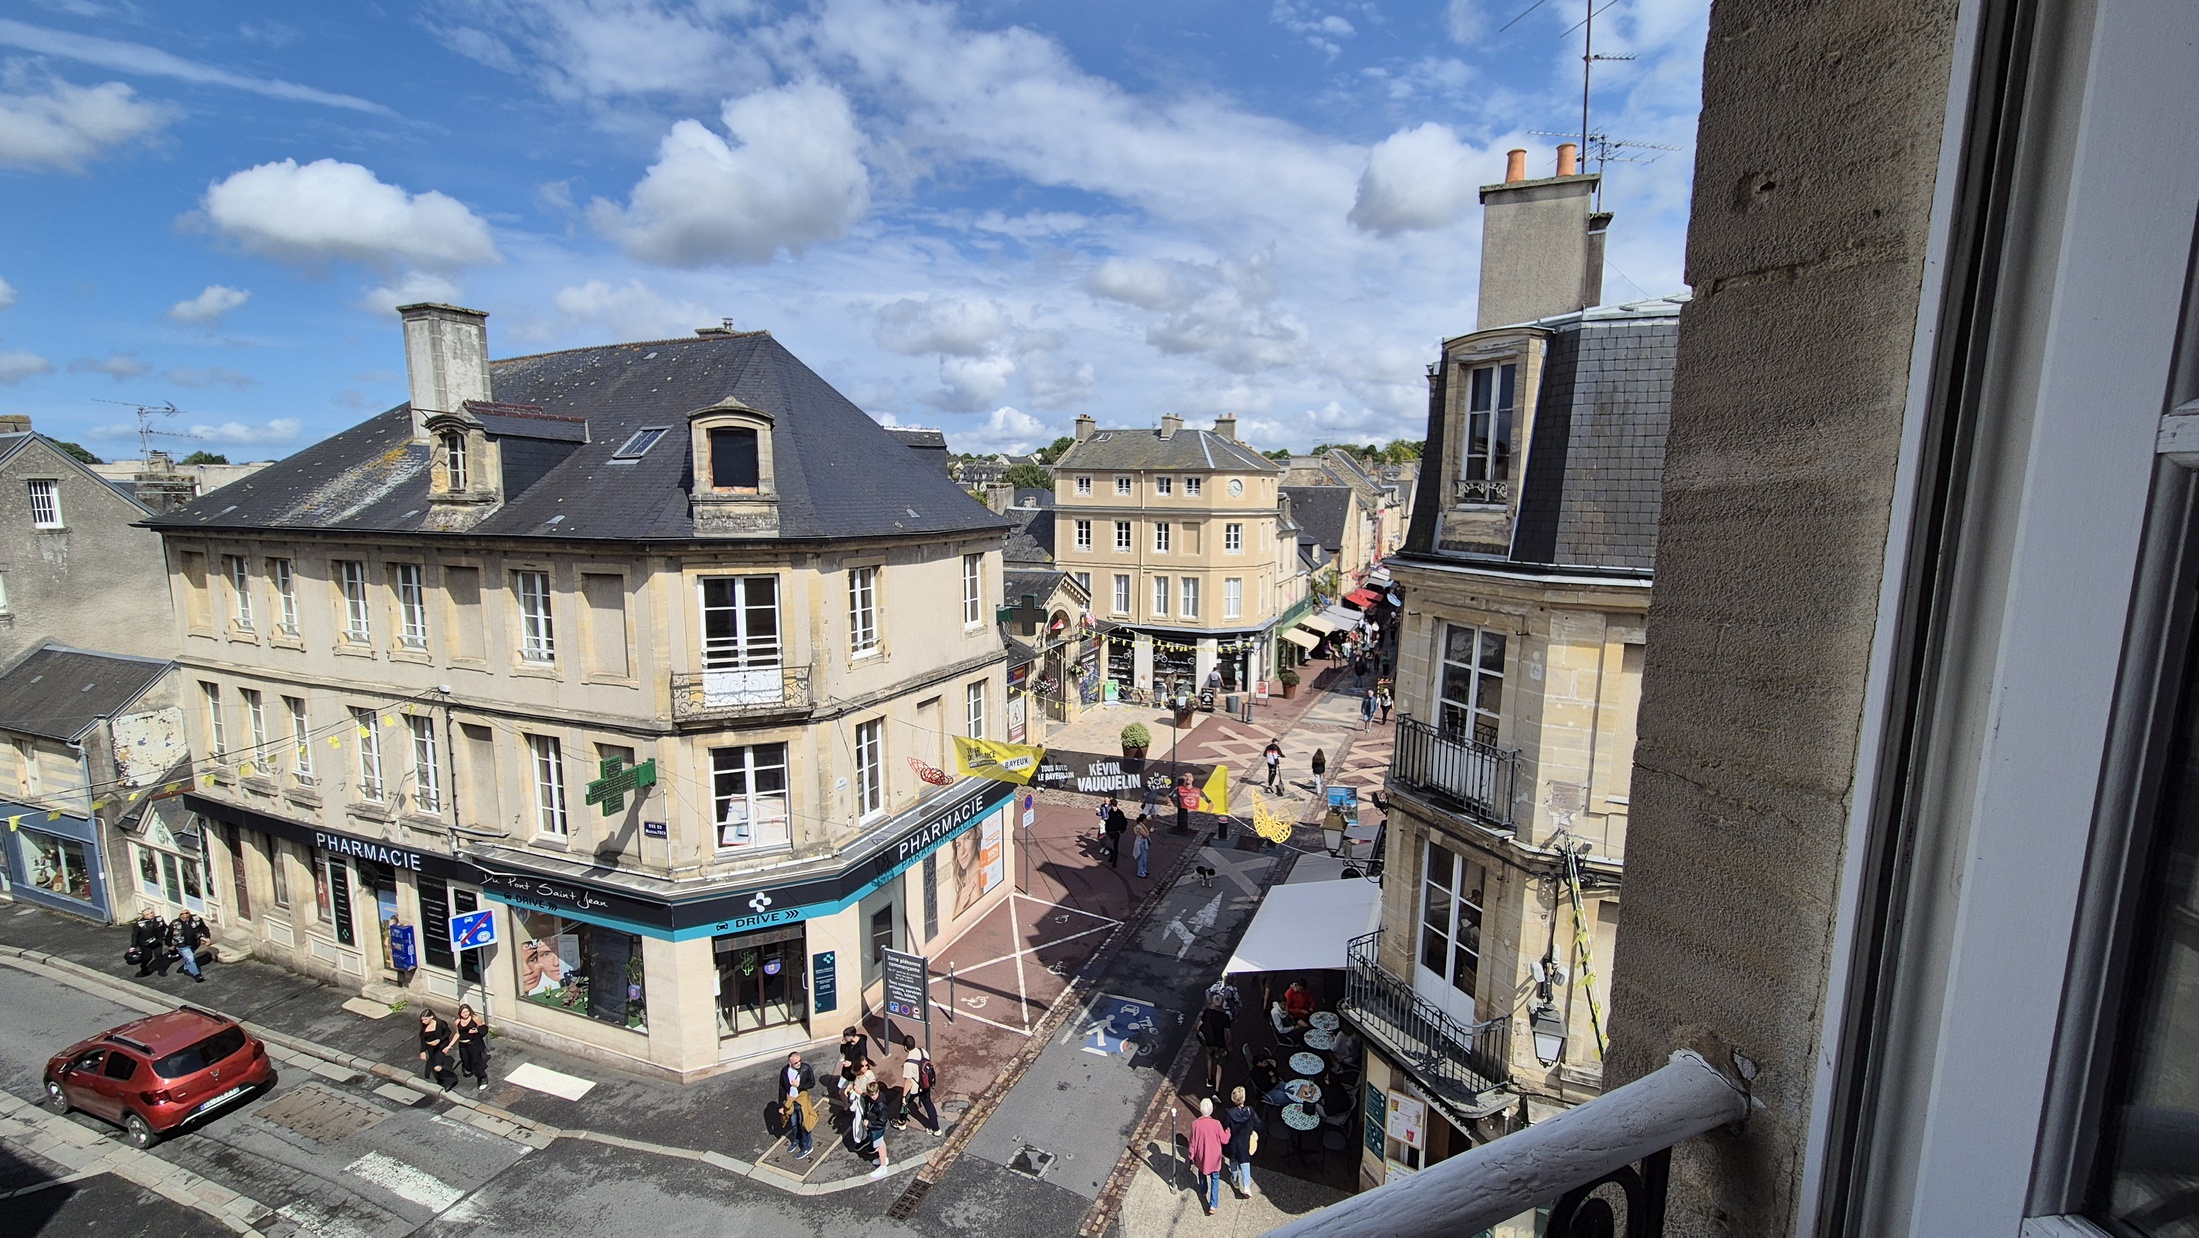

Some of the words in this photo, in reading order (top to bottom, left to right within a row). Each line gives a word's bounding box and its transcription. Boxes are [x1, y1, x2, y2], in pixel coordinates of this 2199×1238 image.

[1005, 757, 1029, 769] BAYEUX
[1041, 764, 1055, 772] TOUS
[1088, 760, 1120, 776] KÉVIN
[1038, 773, 1045, 781] LE
[1077, 774, 1141, 792] VAUQUELIN
[899, 796, 984, 860] PHARMACIE
[901, 817, 976, 869] PARAPHARMACIE
[316, 832, 422, 872] PHARMACIE
[480, 873, 500, 885] Du
[507, 877, 531, 890] Pont
[536, 883, 577, 900] Saint
[577, 891, 609, 909] Jean
[515, 894, 545, 909] DRIVE
[735, 912, 780, 928] DRIVE
